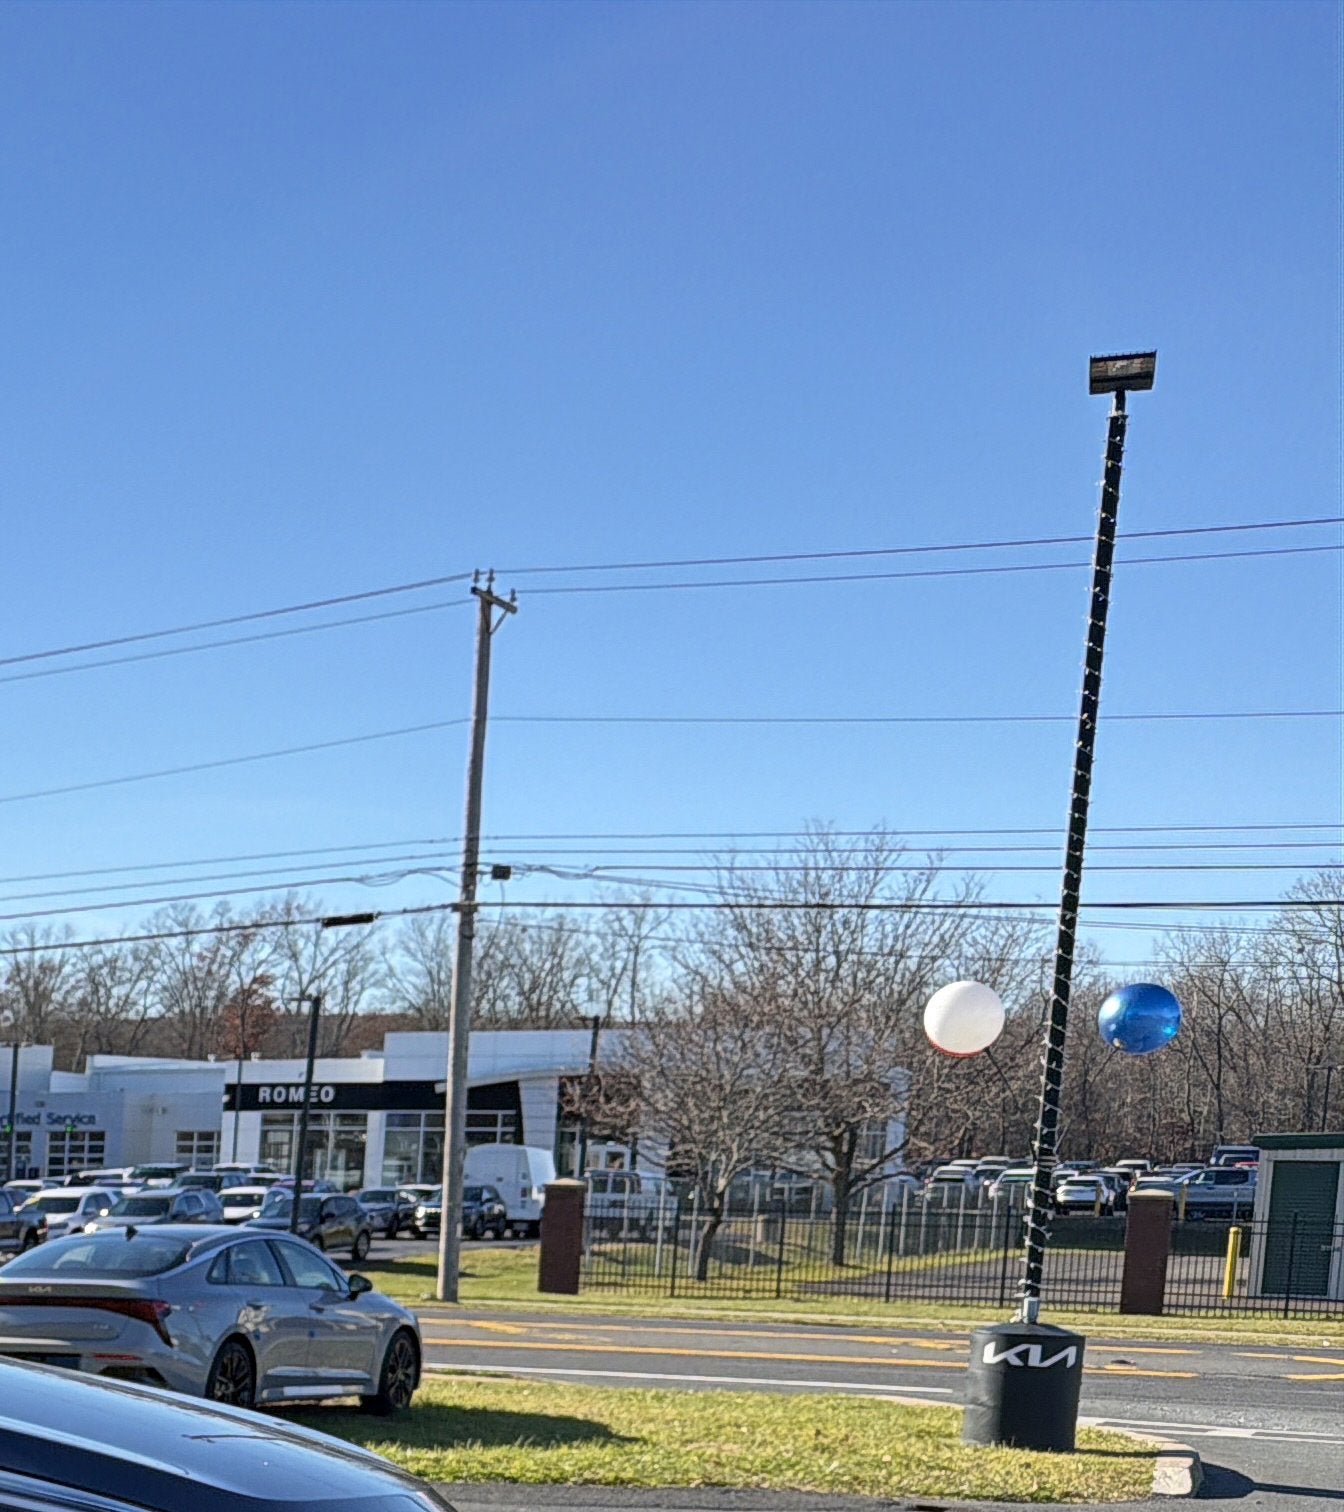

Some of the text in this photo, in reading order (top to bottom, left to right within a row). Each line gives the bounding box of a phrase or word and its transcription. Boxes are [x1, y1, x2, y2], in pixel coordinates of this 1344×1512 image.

[258, 1085, 336, 1103] ROMEO
[46, 1112, 97, 1126] Service
[982, 1341, 1078, 1369] KIA
